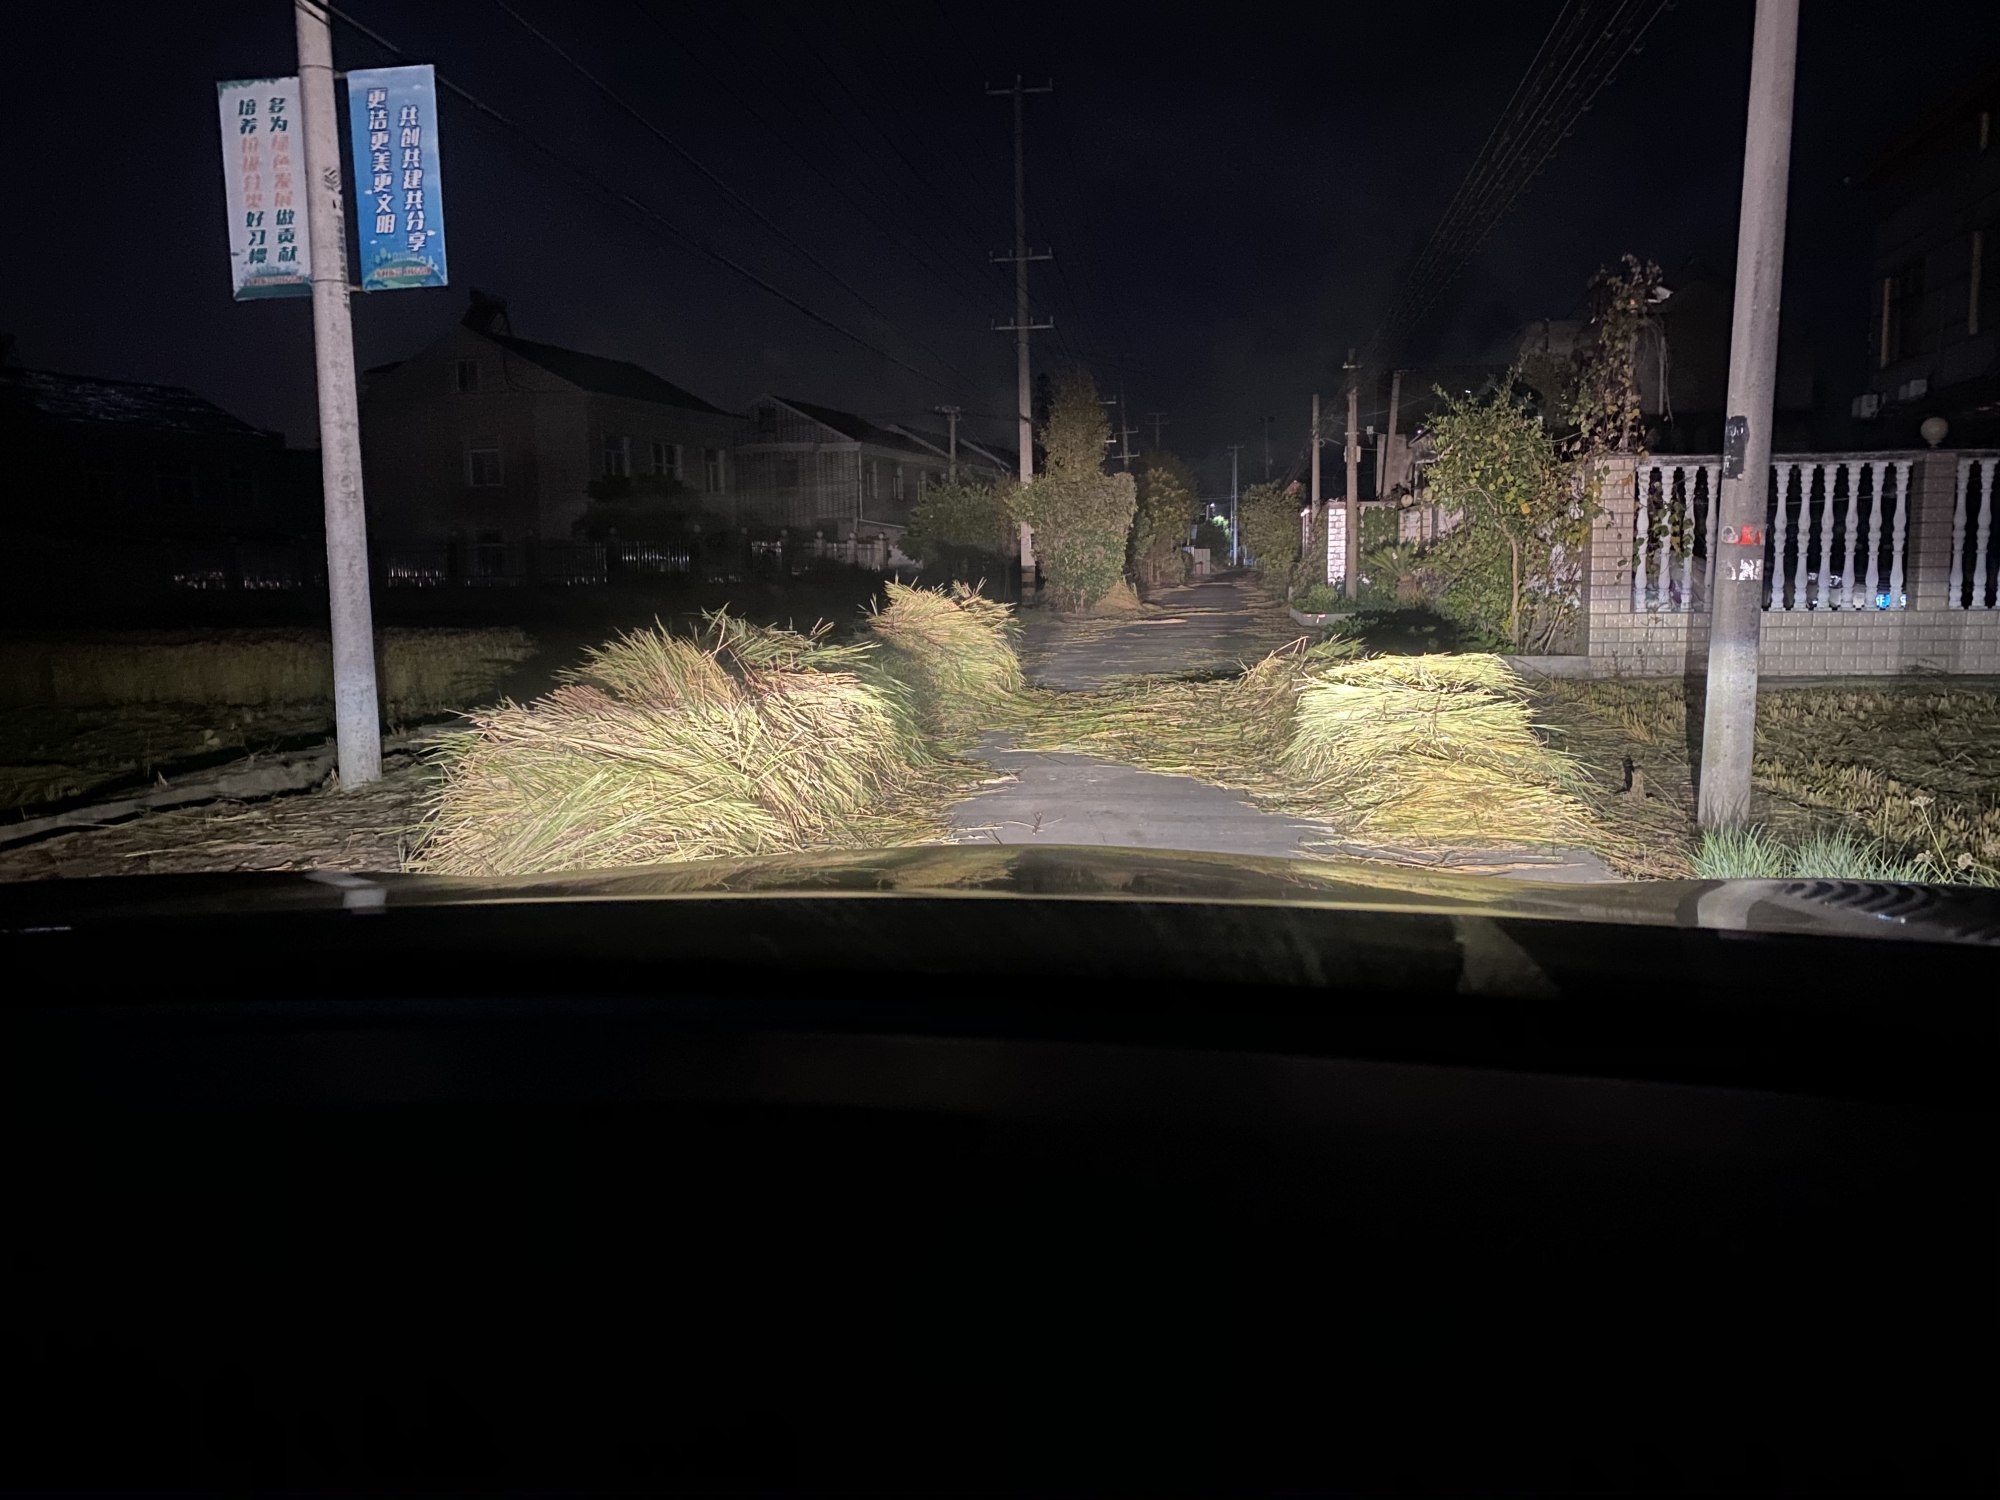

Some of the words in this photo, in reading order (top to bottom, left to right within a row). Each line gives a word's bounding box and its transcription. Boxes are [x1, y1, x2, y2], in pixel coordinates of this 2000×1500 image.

[238, 98, 268, 265] 培养垃圾分类好习惯
[367, 88, 397, 235] 更洁更美更文明
[398, 105, 429, 252] 共创共建共分享
